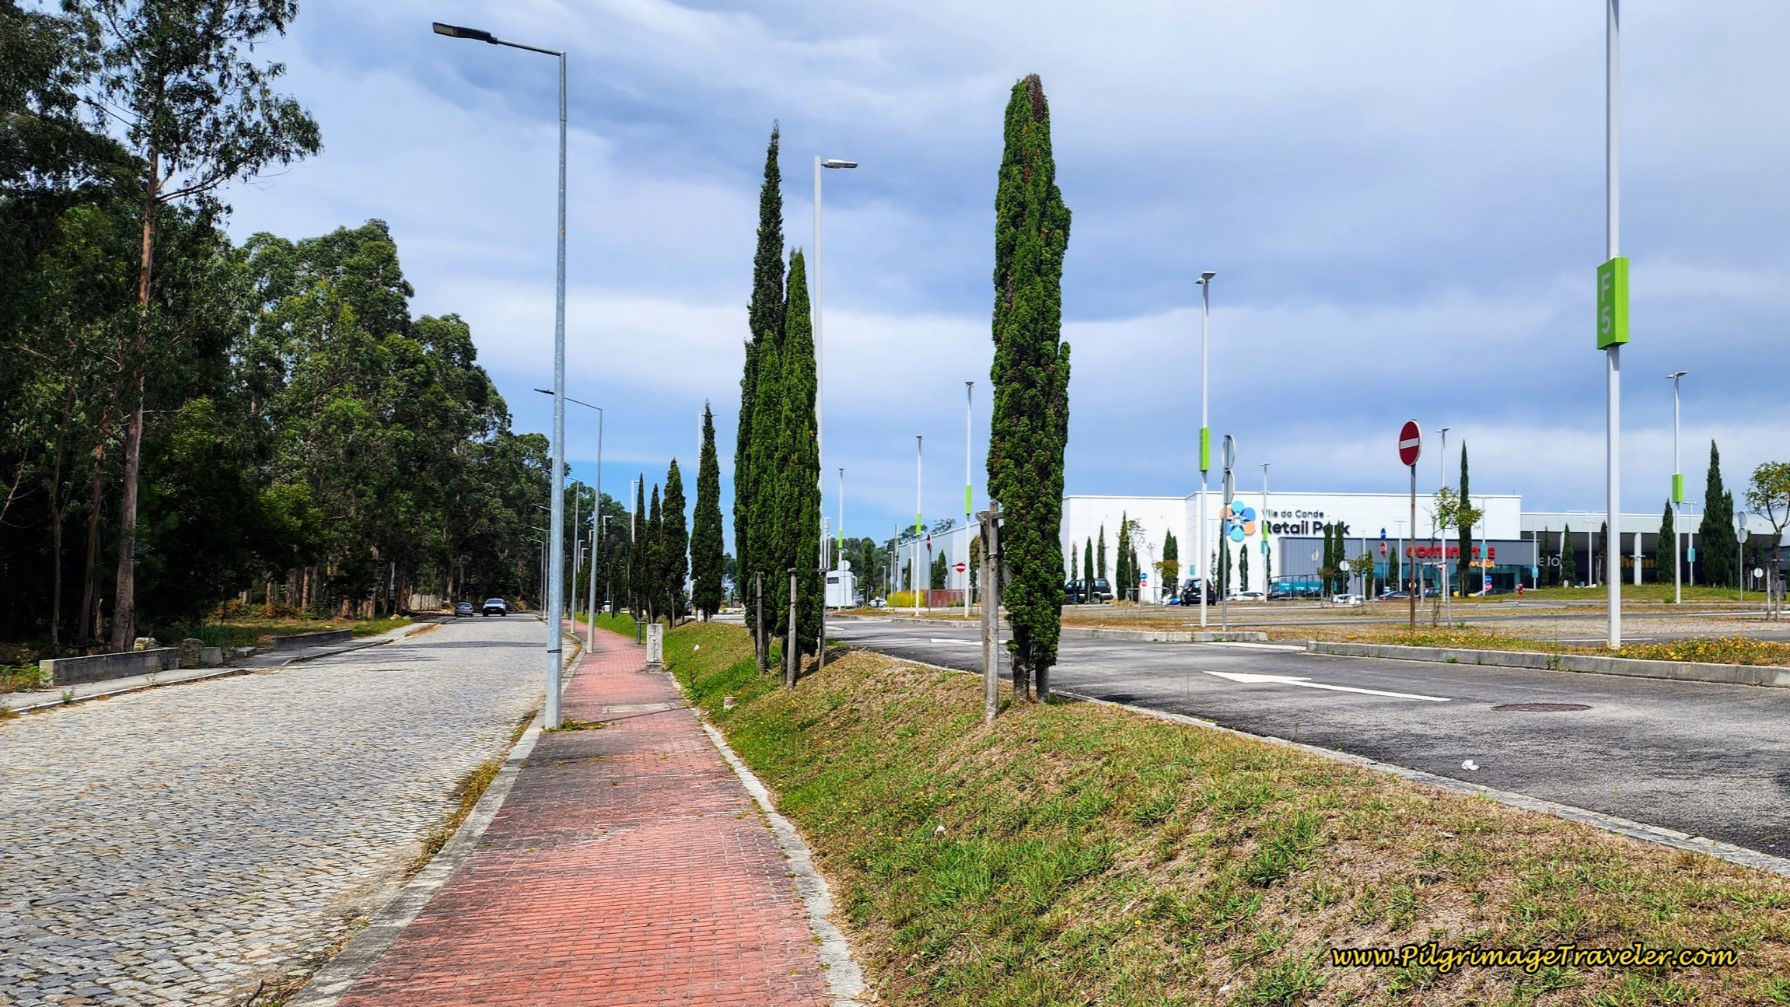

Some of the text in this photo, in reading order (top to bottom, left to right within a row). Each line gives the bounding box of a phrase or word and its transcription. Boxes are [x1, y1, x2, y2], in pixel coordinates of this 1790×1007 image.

[1601, 272, 1611, 302] F
[1601, 306, 1611, 334] 5
[1281, 509, 1292, 518] do
[1295, 509, 1324, 518] Conde
[1261, 520, 1309, 535] Retail
